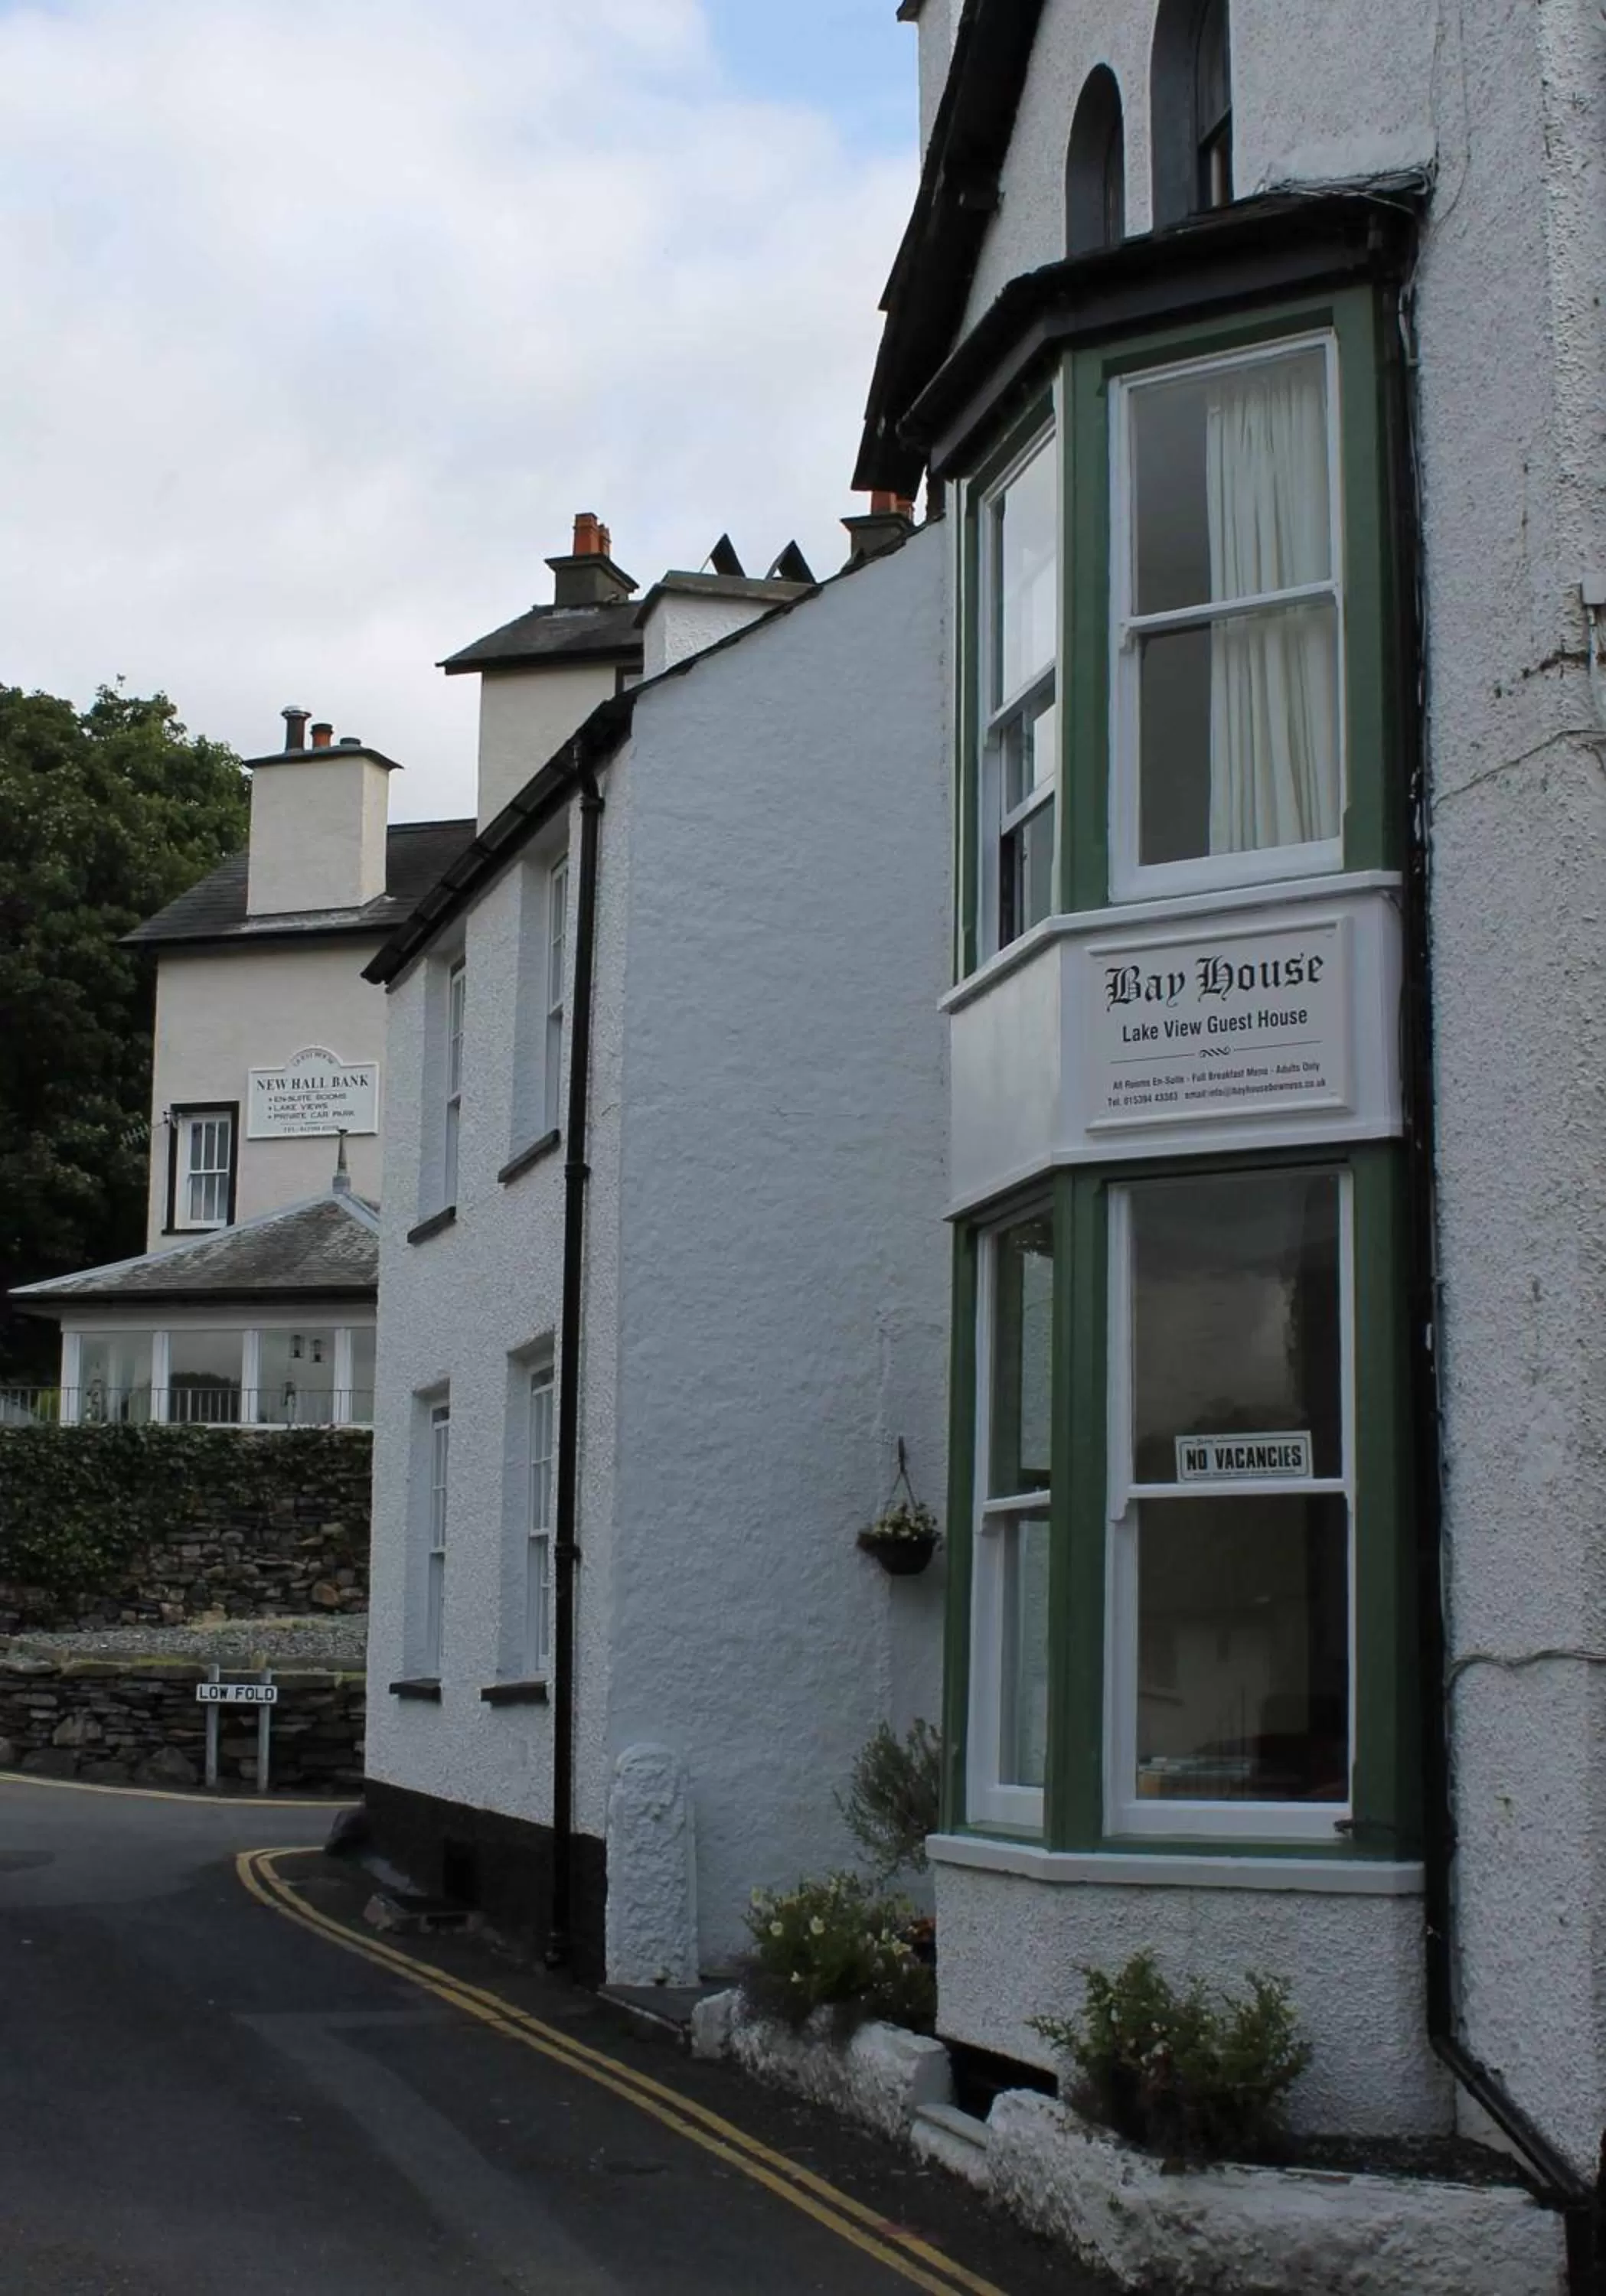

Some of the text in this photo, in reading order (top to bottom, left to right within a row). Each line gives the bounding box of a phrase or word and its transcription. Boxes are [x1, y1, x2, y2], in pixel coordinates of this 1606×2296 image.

[1105, 952, 1324, 1012] Bay House
[1122, 1008, 1308, 1042] Lake View Guest House
[256, 1074, 369, 1091] NEW HALL BANK
[300, 1102, 328, 1110] VIEWS
[273, 1112, 307, 1120] PRIVATE
[1187, 1444, 1301, 1470] NO VACANCIES
[199, 1684, 275, 1701] LOW FOLD
